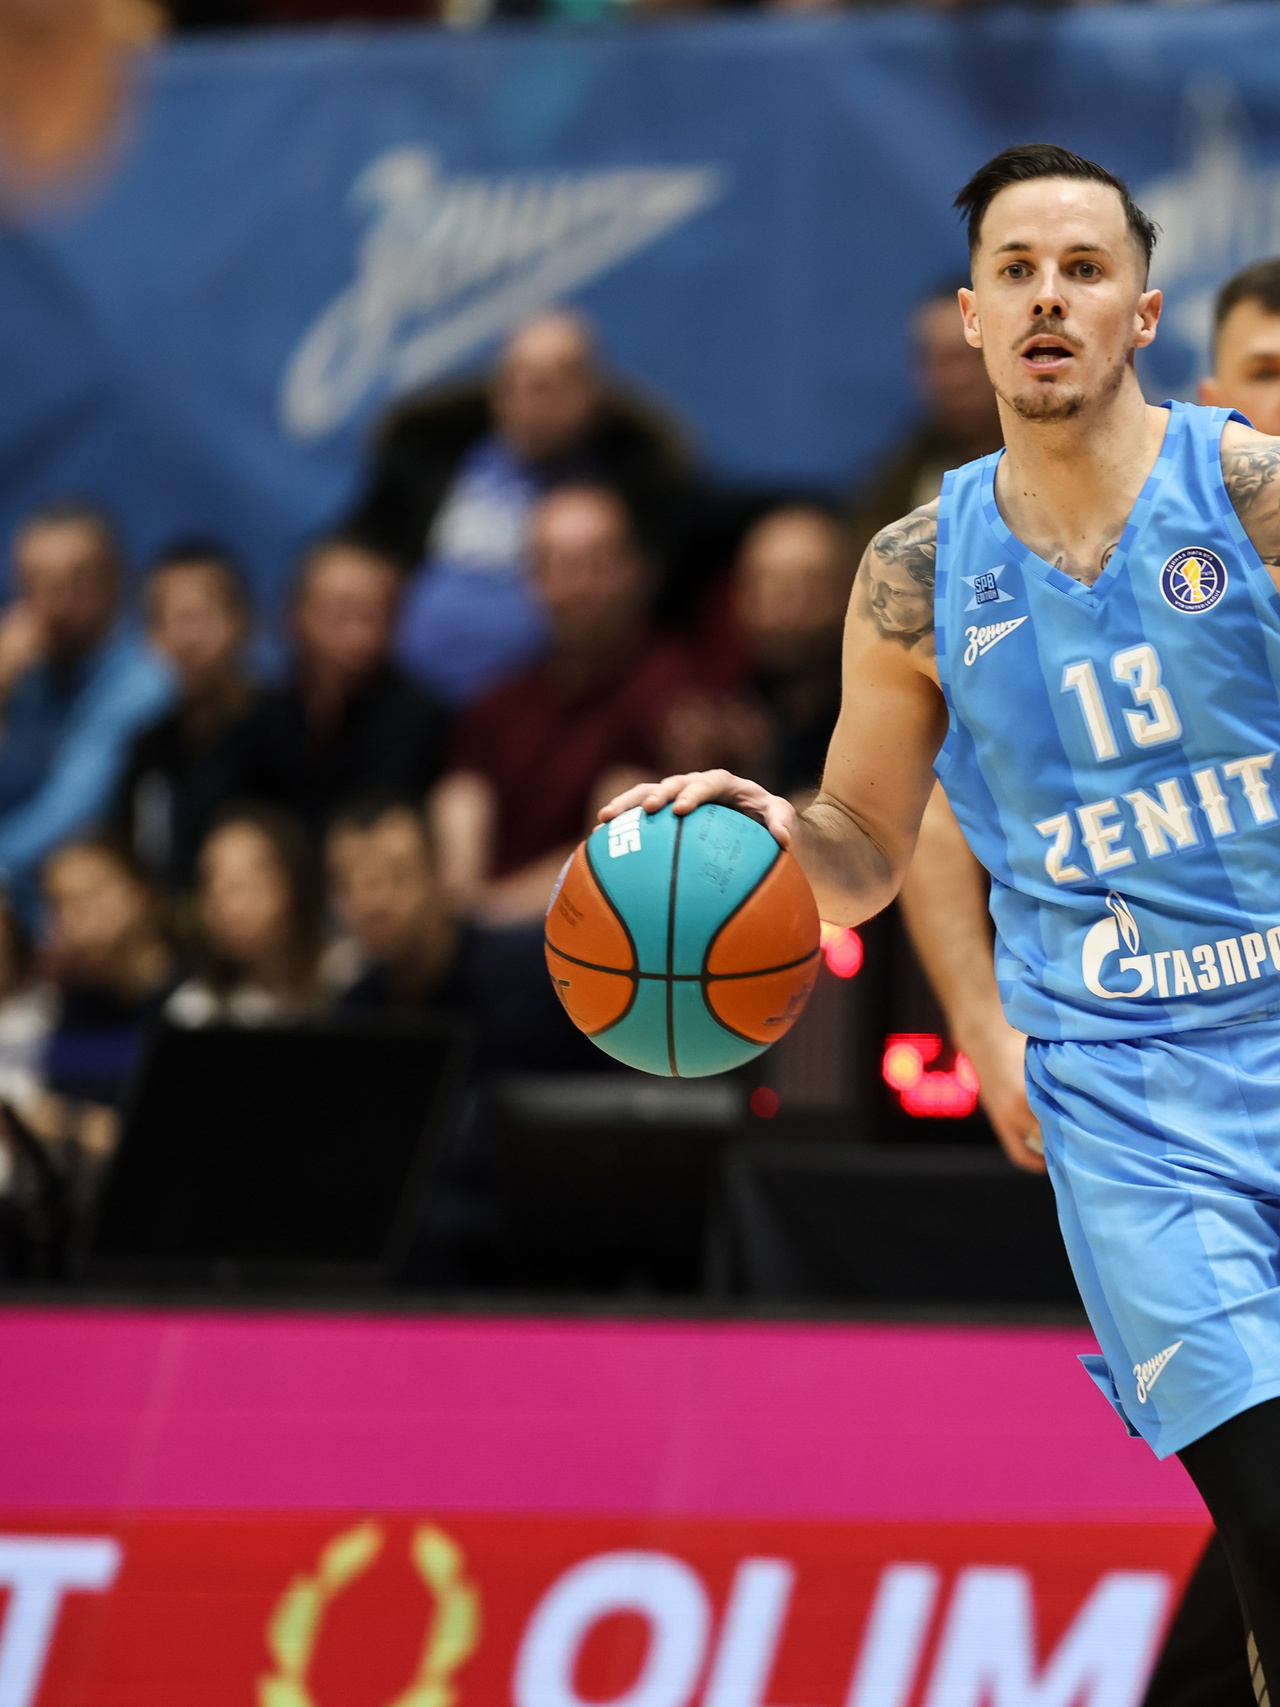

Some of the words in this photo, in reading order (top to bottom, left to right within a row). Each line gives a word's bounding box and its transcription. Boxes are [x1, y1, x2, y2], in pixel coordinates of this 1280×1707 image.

[975, 574, 995, 593] SPB
[963, 615, 1029, 667] Зенит
[1060, 643, 1183, 763] 13
